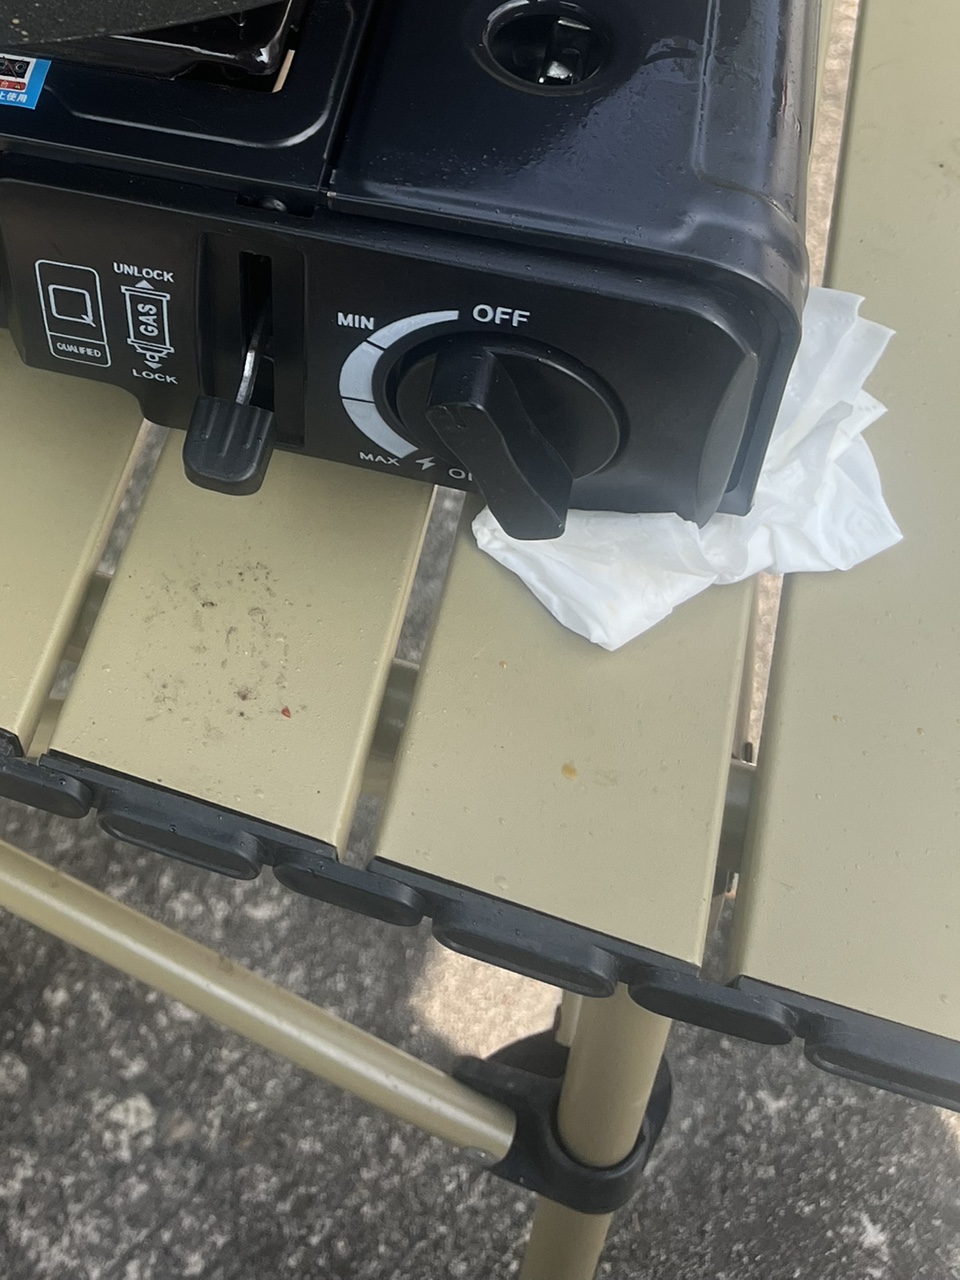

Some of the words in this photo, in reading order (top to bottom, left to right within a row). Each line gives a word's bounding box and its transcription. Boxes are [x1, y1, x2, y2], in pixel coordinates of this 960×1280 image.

[113, 262, 175, 283] UNLOCK
[137, 303, 159, 337] GAS
[337, 312, 374, 330] MIN
[472, 304, 530, 328] OFF
[56, 342, 101, 358] QUALIFIED
[132, 368, 178, 385] LOCK
[359, 451, 400, 467] MAX
